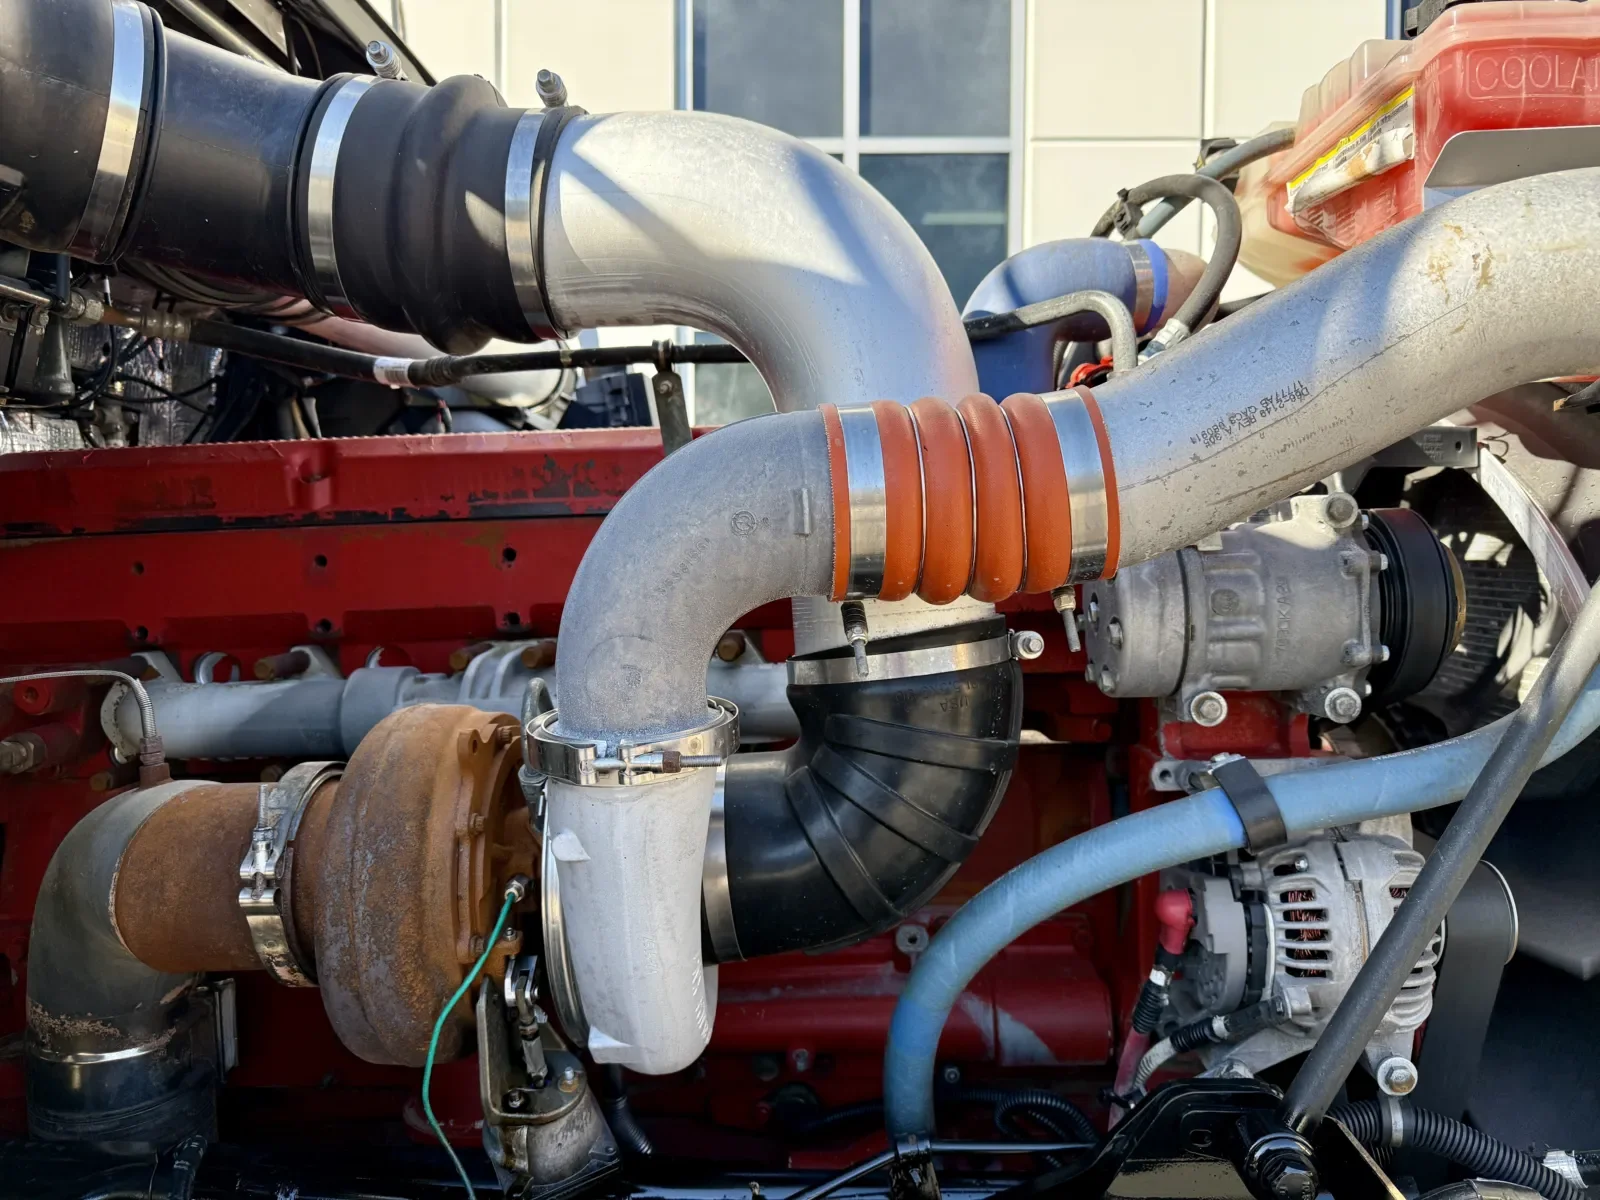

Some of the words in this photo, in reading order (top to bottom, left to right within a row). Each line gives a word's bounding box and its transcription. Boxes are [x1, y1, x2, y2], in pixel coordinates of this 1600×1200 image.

[1238, 415, 1257, 430] REV
[1203, 432, 1222, 448] 305
[940, 695, 969, 712] USA
